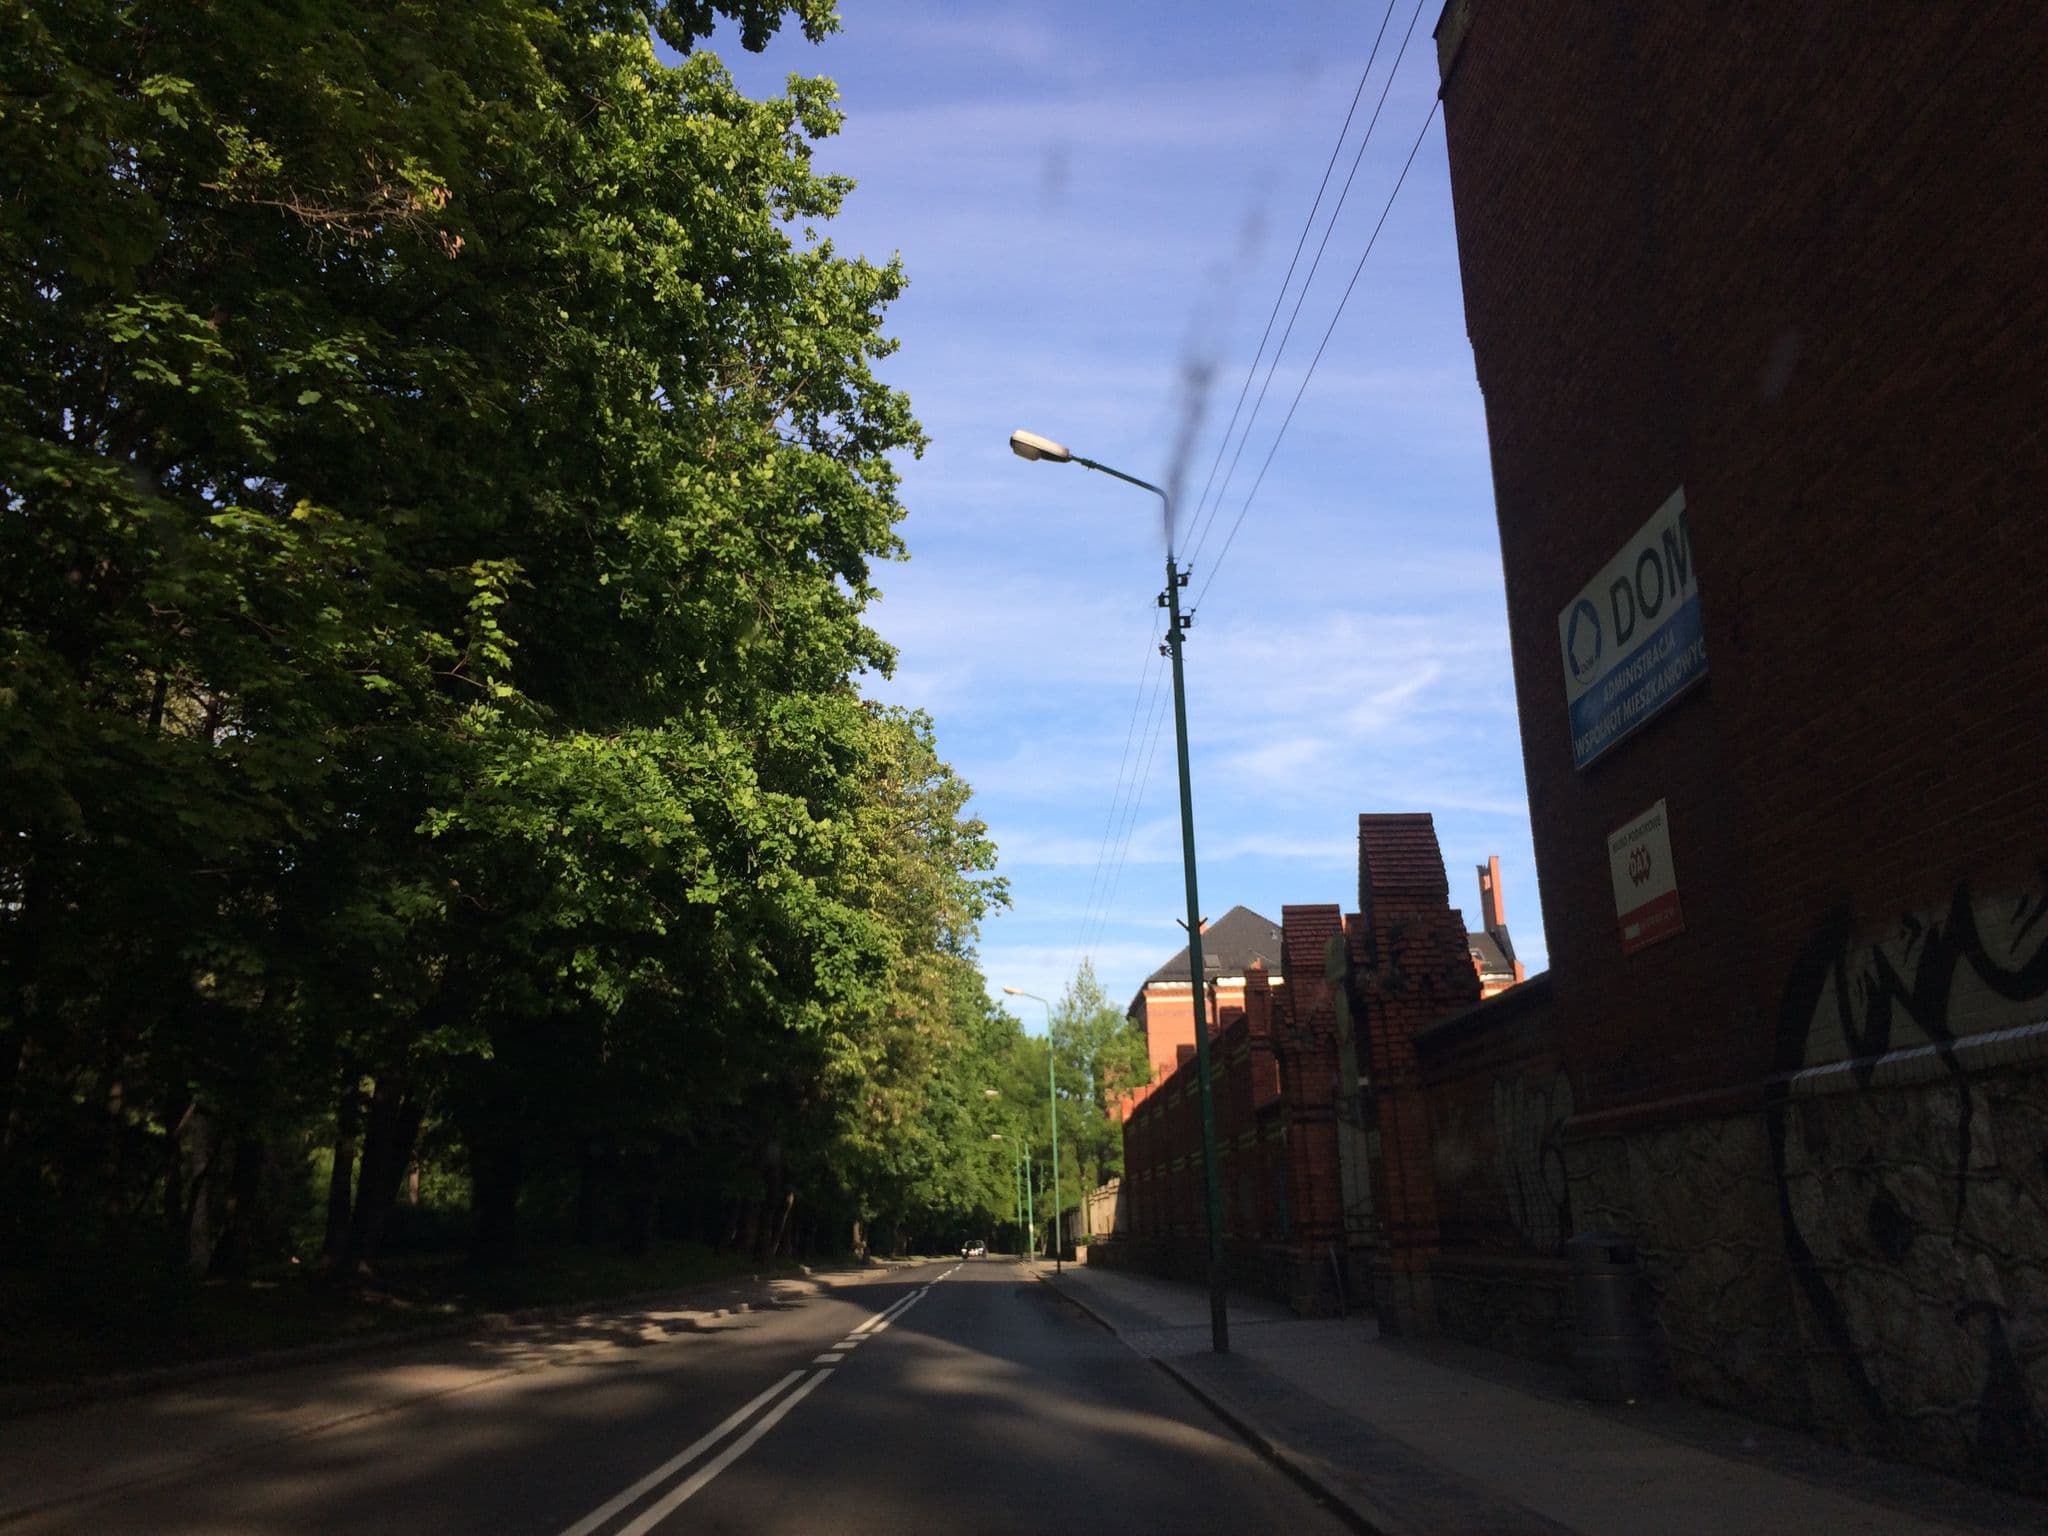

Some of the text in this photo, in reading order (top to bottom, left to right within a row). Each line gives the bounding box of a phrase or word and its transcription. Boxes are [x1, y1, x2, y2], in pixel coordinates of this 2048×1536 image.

[1609, 510, 1695, 647] DOM
[1604, 628, 1675, 702] ADMINISTRACJA
[1623, 635, 1707, 722] MIESZKANIOWYC
